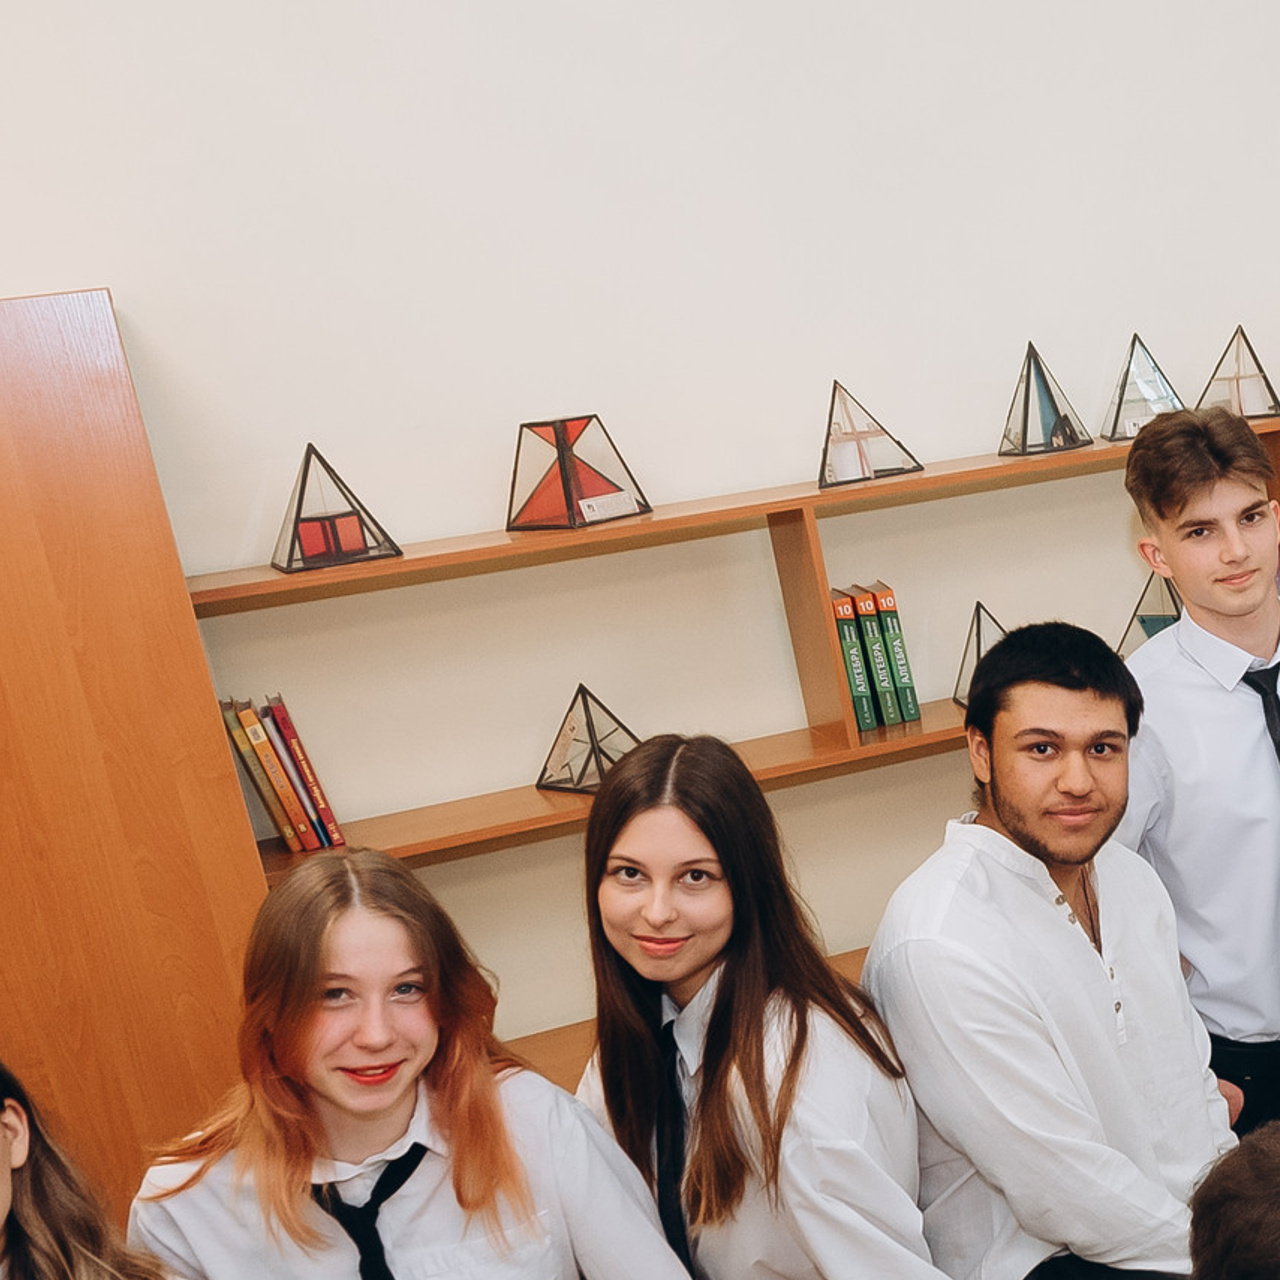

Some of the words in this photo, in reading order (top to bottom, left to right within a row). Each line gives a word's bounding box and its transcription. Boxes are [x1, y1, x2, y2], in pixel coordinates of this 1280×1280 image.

[837, 604, 852, 616] 10
[859, 600, 874, 612] 10
[880, 596, 894, 608] 10
[849, 647, 867, 692] АЛГЕБРА
[872, 642, 890, 688] АЛГЕБРА
[893, 638, 911, 683] АЛГЕБРА
